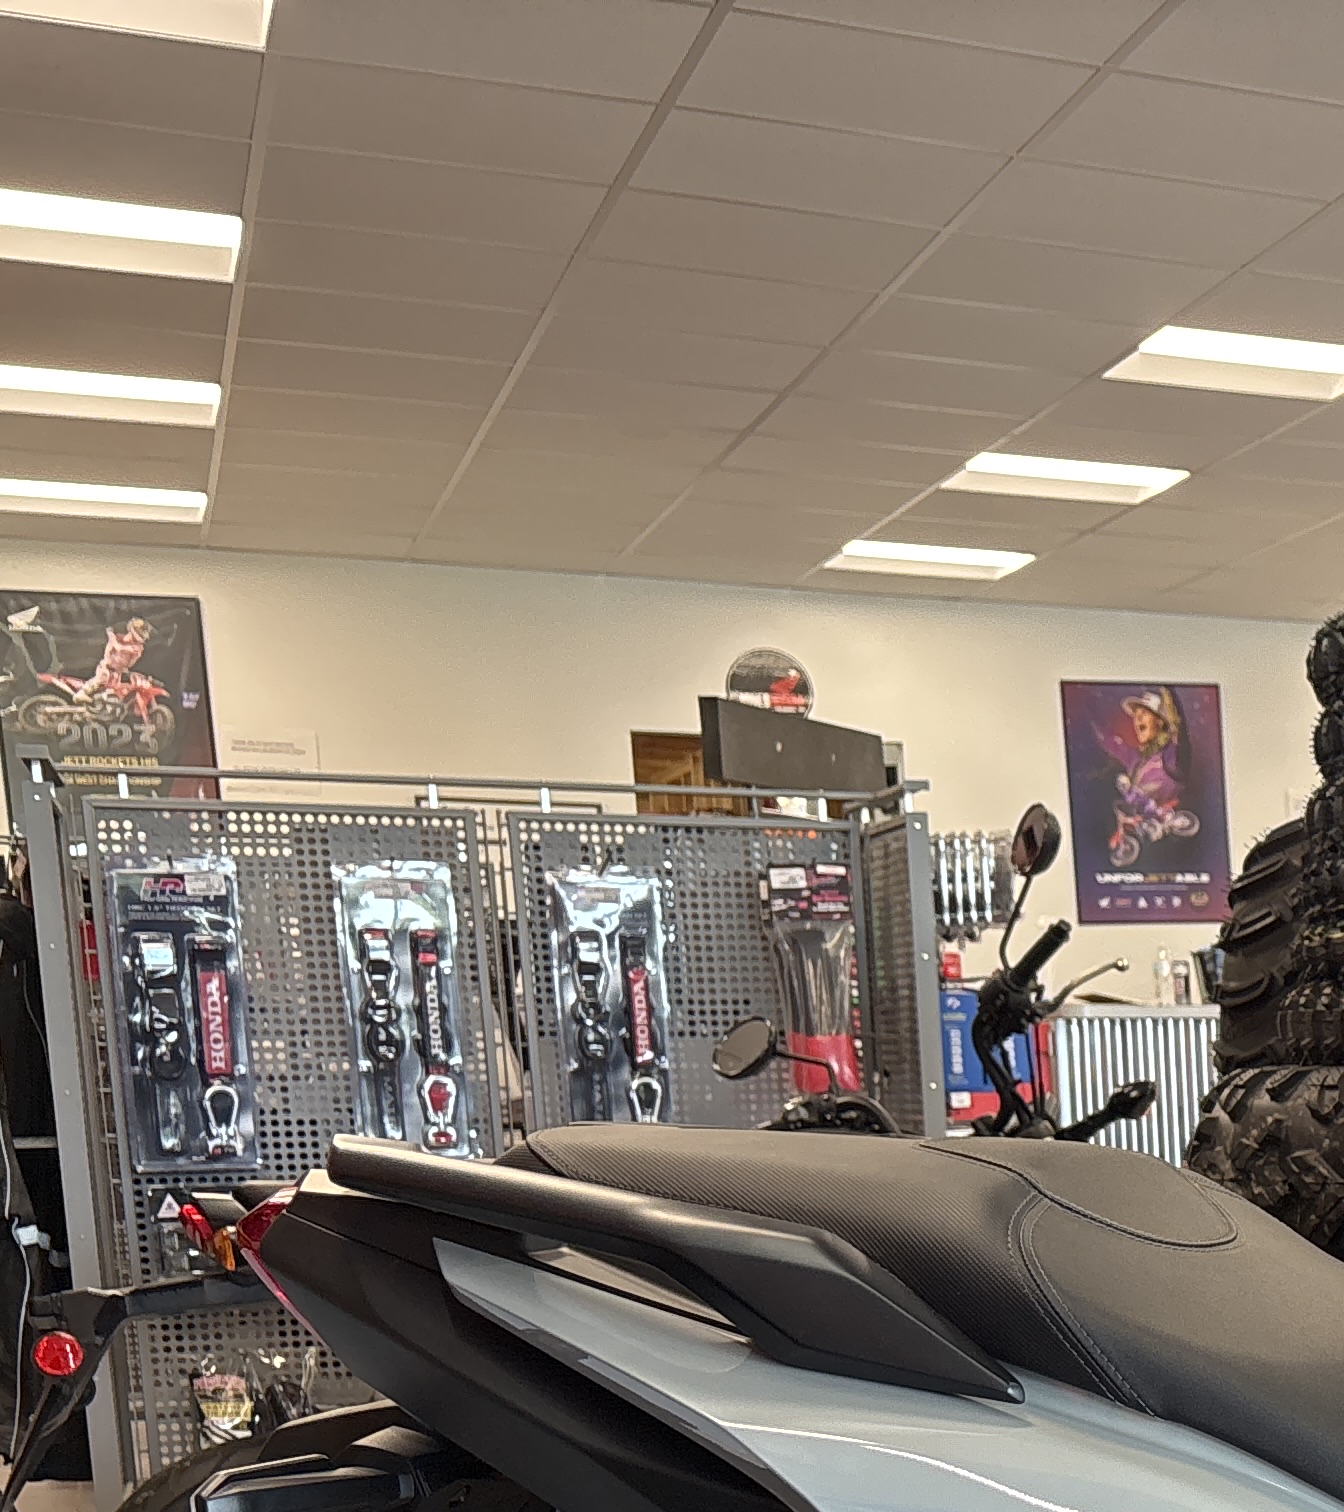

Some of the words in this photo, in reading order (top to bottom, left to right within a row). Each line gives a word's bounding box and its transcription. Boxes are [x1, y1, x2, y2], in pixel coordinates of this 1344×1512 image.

[58, 722, 159, 753] 2023
[205, 974, 227, 1071] HONDA
[425, 967, 444, 1057] HONDA
